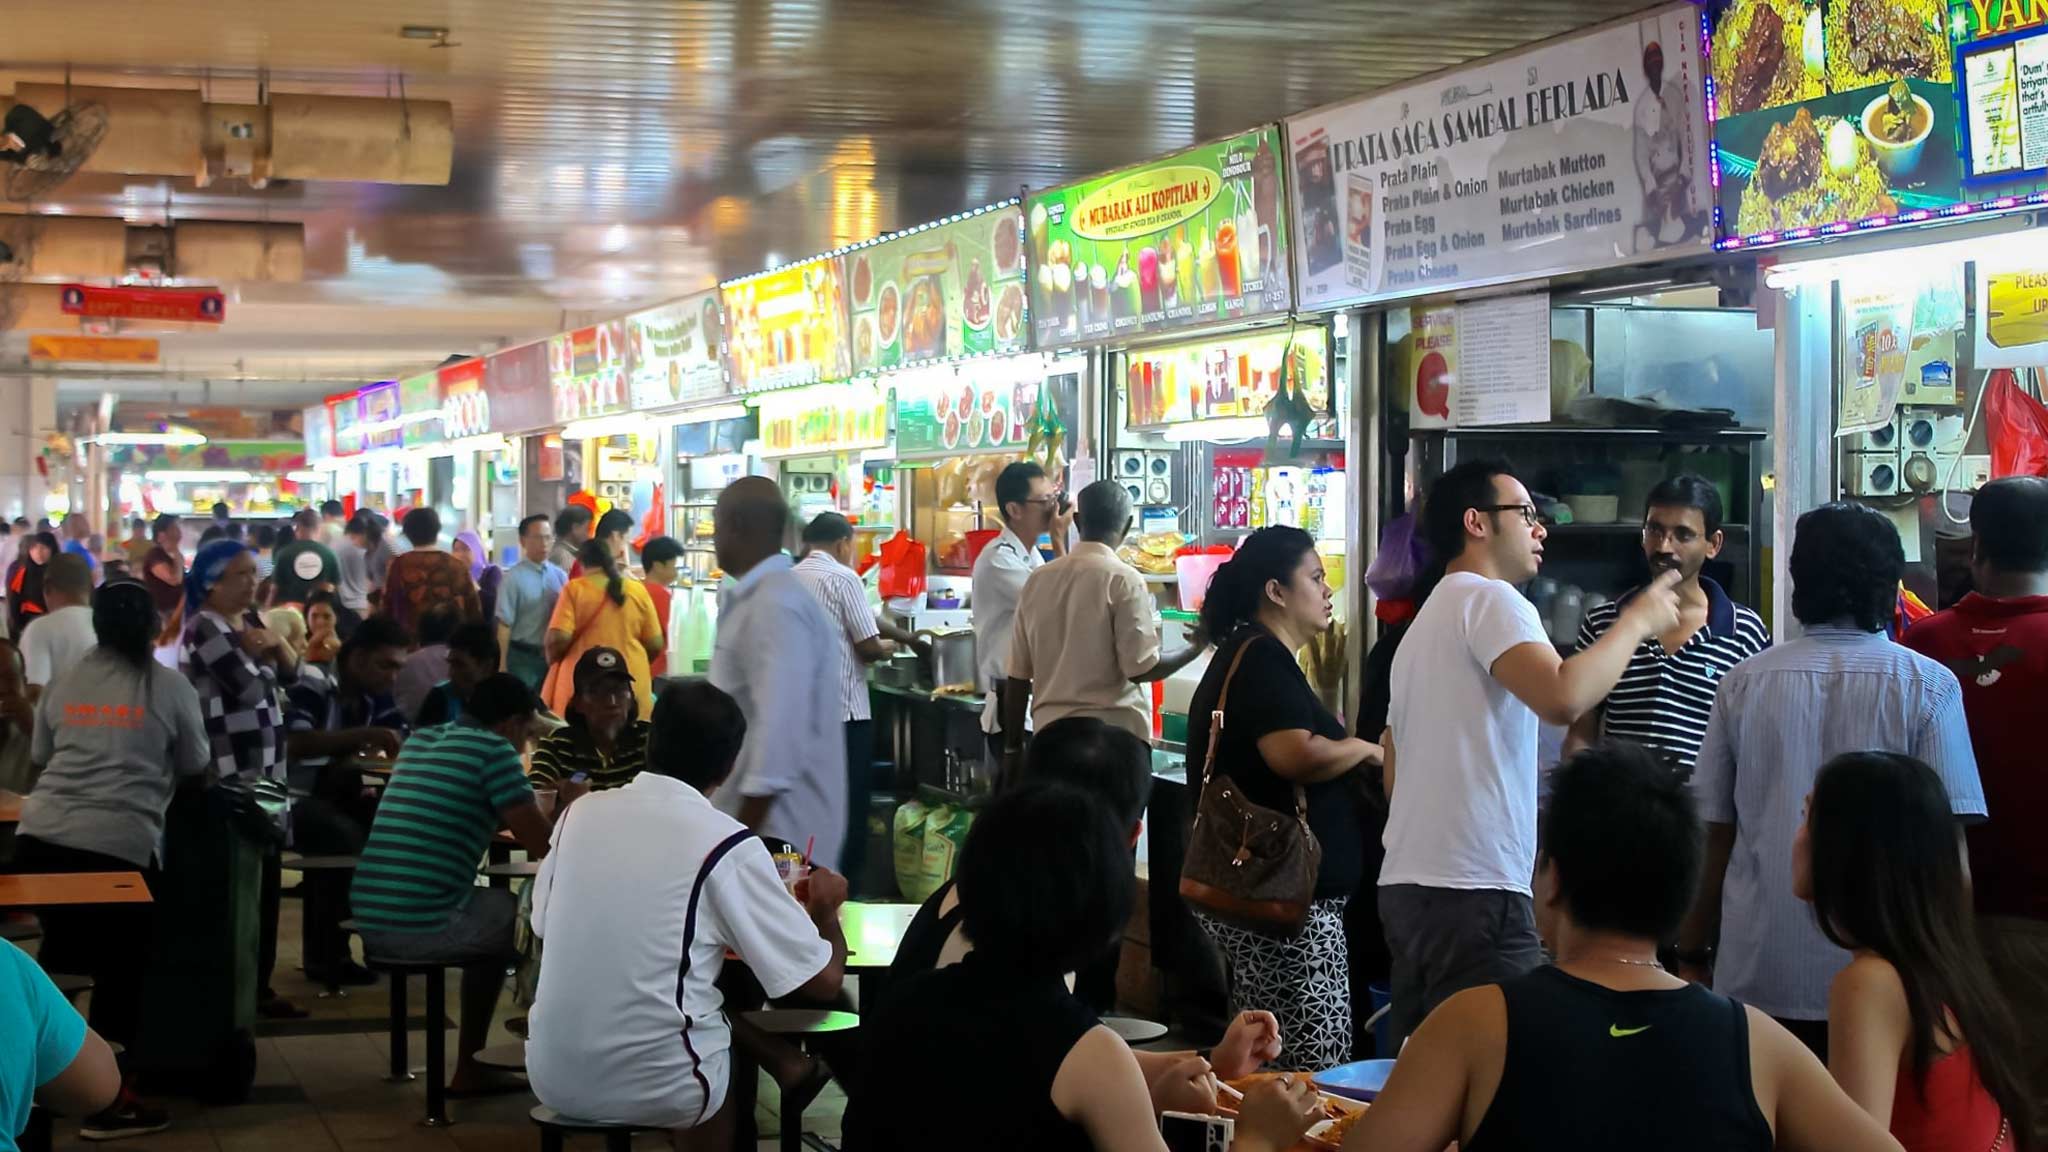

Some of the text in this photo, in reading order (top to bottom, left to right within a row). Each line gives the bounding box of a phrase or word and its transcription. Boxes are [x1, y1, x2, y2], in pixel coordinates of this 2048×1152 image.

[1333, 130, 1389, 173] PRATA
[1391, 117, 1440, 160] SAGA
[1443, 97, 1522, 148] SAMBAL
[1526, 67, 1630, 127] BERLADA
[1380, 161, 1438, 189] Prata Plain
[1497, 152, 1606, 190] Murtabak Mutton
[1089, 181, 1199, 227] MUBARAK ALI KOPITIAM
[1382, 178, 1489, 214] Prata Plain & Onion
[1499, 179, 1615, 216] Murtabak Chicken
[1384, 214, 1436, 239] Prata Egg
[1501, 207, 1623, 242] Murtabak Sardines
[1385, 242, 1414, 262] Prata
[1416, 239, 1437, 260] Egg
[1452, 230, 1486, 251] Onion
[1387, 267, 1416, 286] Prata
[1415, 334, 1453, 351] PLEASE
